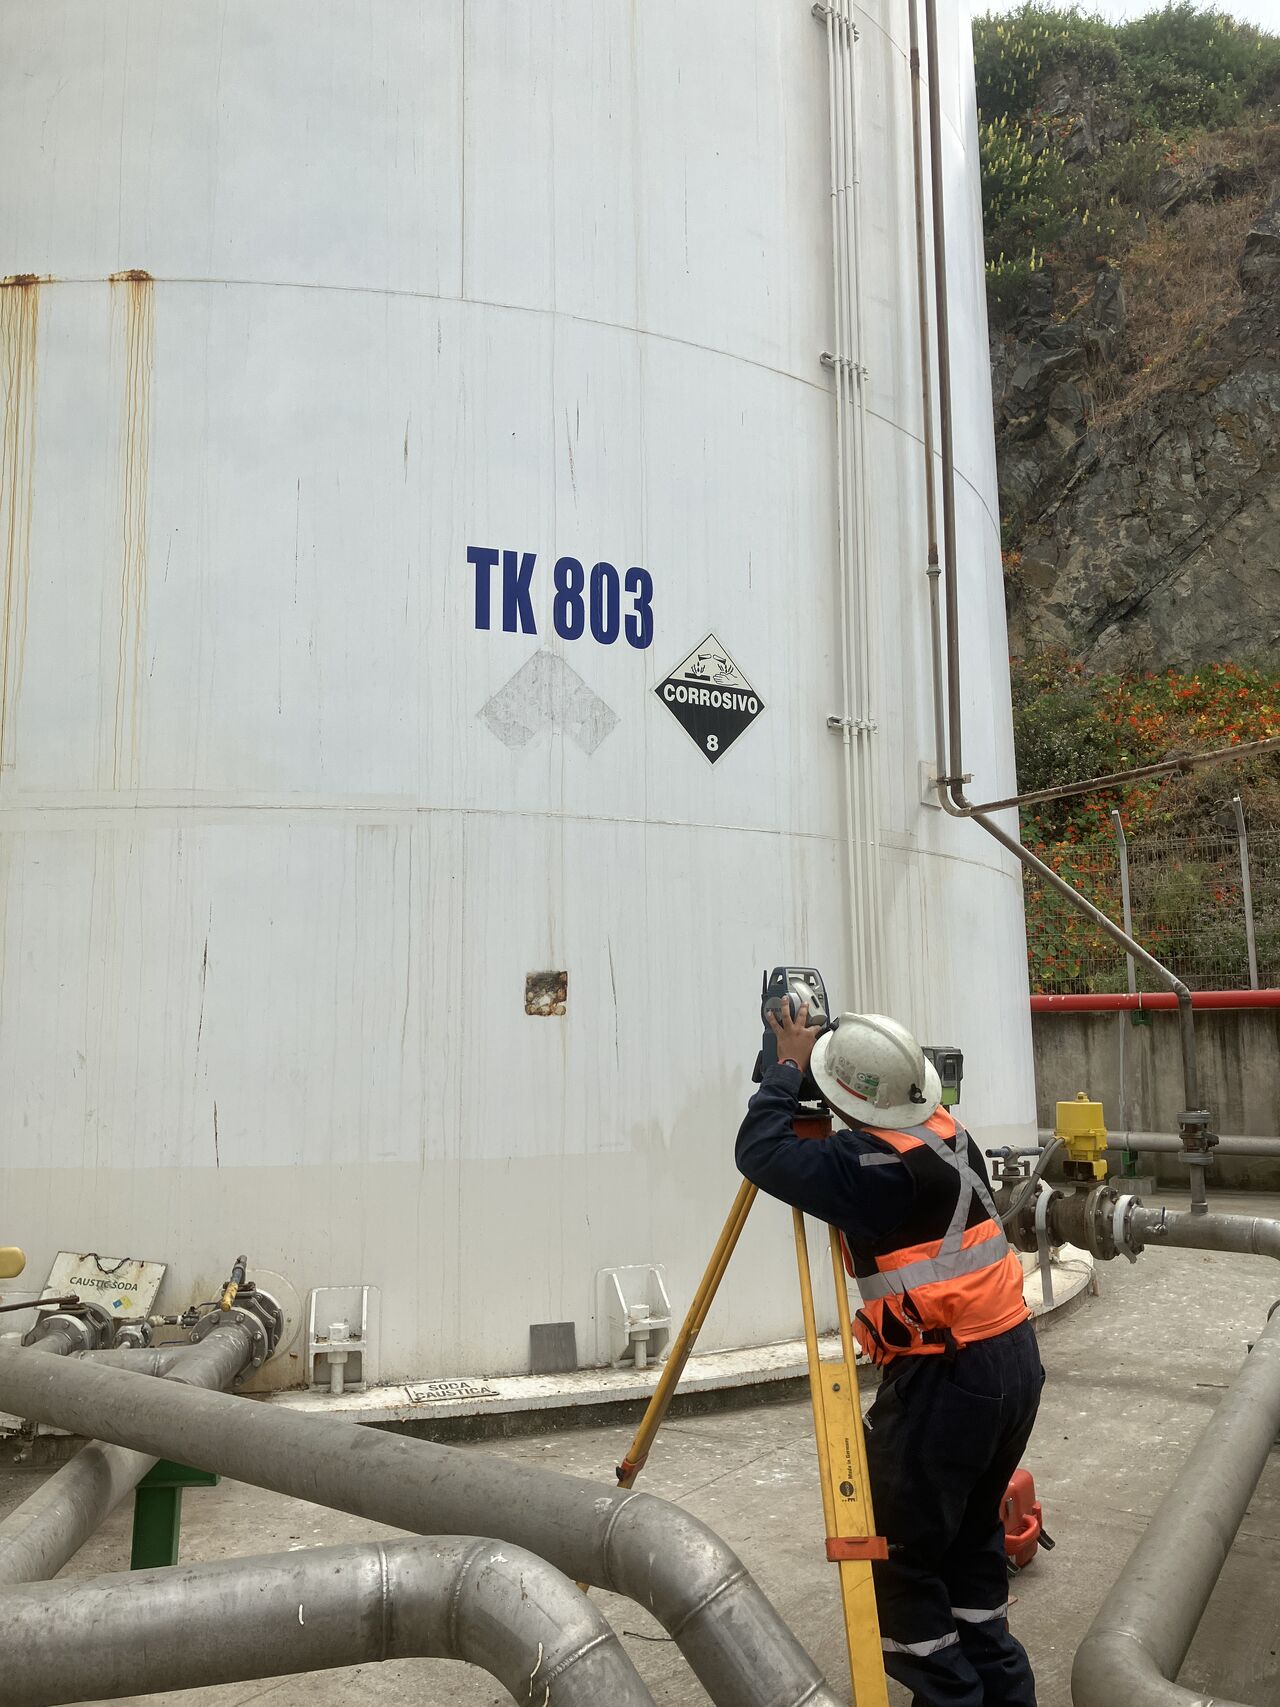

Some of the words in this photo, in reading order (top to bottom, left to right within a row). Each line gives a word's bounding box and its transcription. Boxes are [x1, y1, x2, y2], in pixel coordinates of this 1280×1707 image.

[466, 545, 538, 635] TK
[553, 556, 654, 649] 803
[663, 683, 758, 715] CORROSIVO
[706, 734, 719, 752] 8
[69, 1276, 111, 1289] CAUSTIC
[111, 1280, 138, 1292] SODA
[414, 1386, 491, 1400] CAUSTICA
[428, 1381, 471, 1391] SODA
